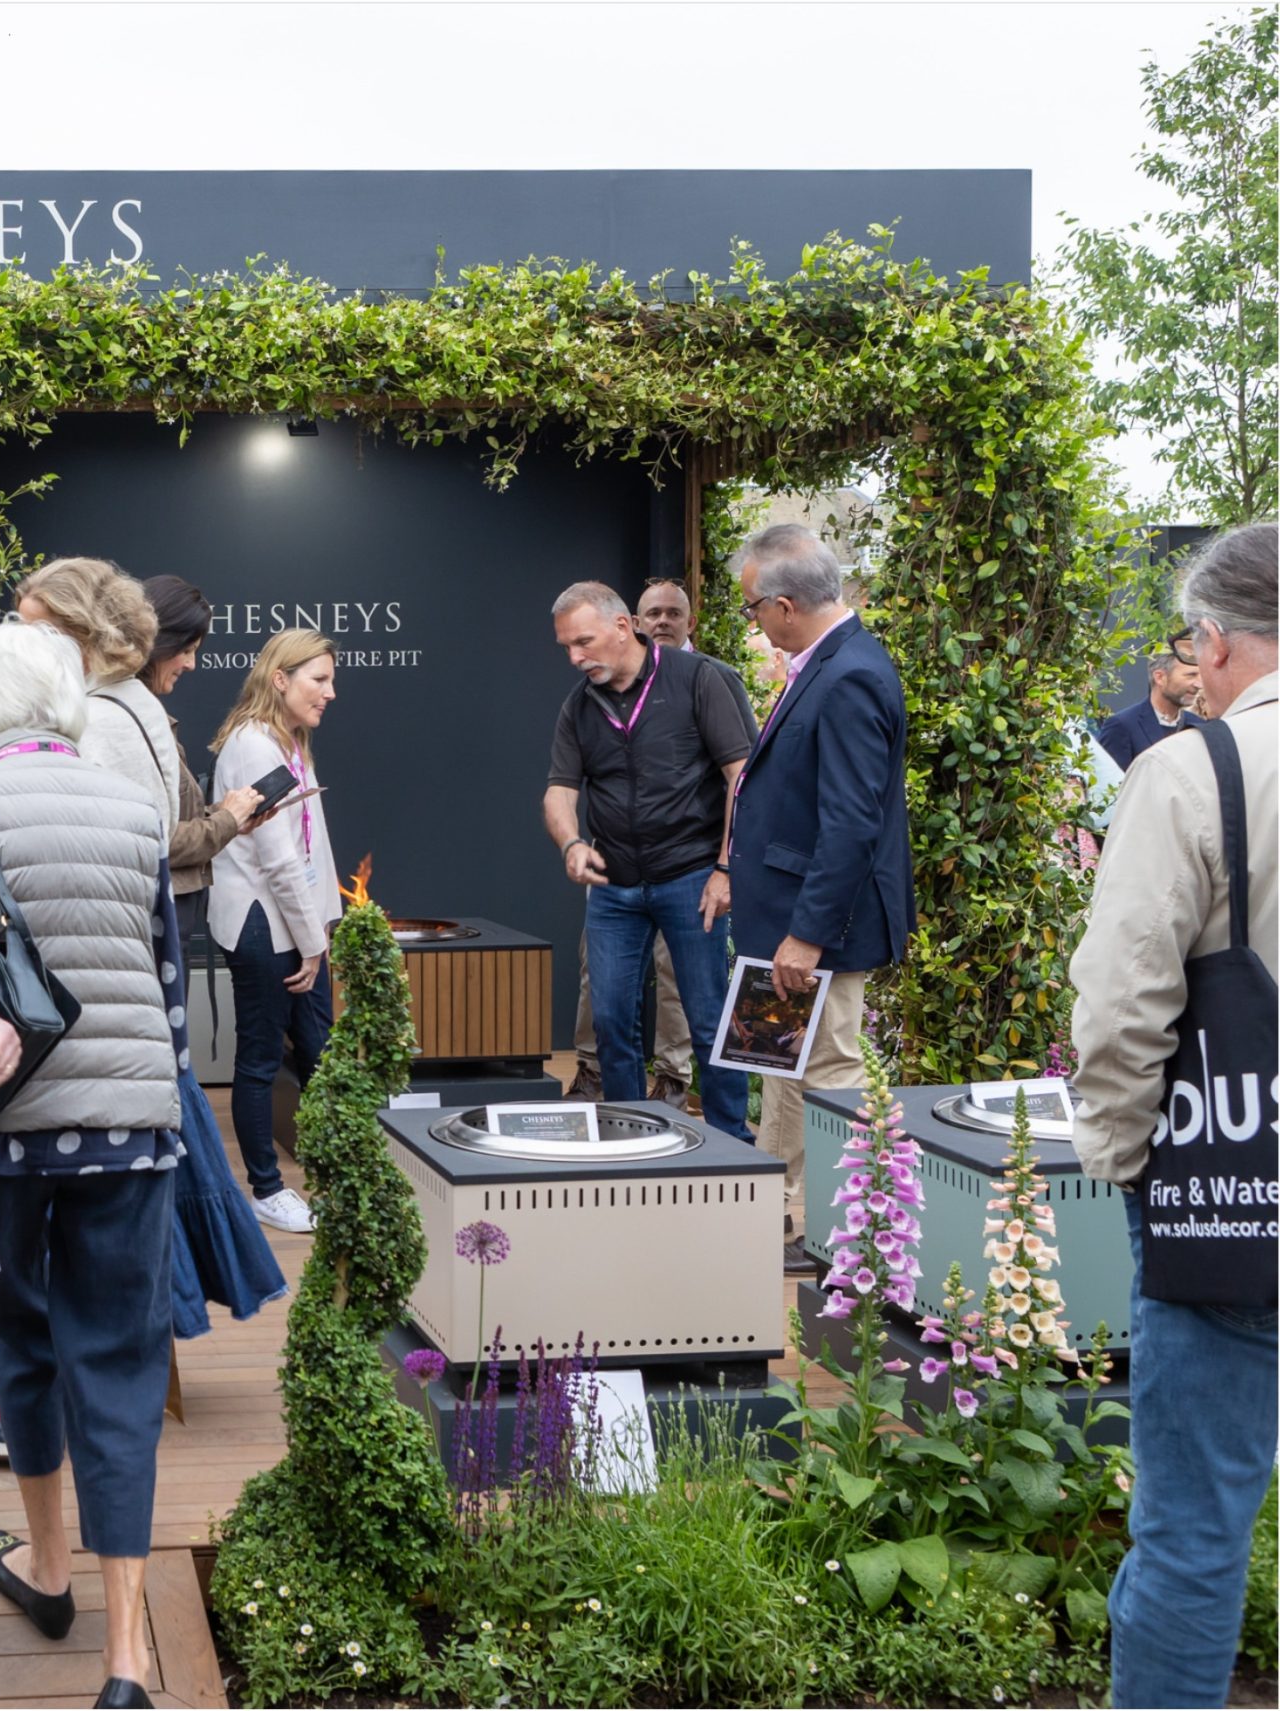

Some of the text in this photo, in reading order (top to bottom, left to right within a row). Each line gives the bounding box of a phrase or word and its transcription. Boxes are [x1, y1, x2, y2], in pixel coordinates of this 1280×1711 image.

[207, 602, 402, 635] HESNEYS
[335, 650, 383, 667] FIRE
[388, 650, 423, 667] PIT
[521, 1115, 564, 1124] CHESNEYS
[1150, 1178, 1182, 1207] Fire
[1188, 1176, 1206, 1206] &
